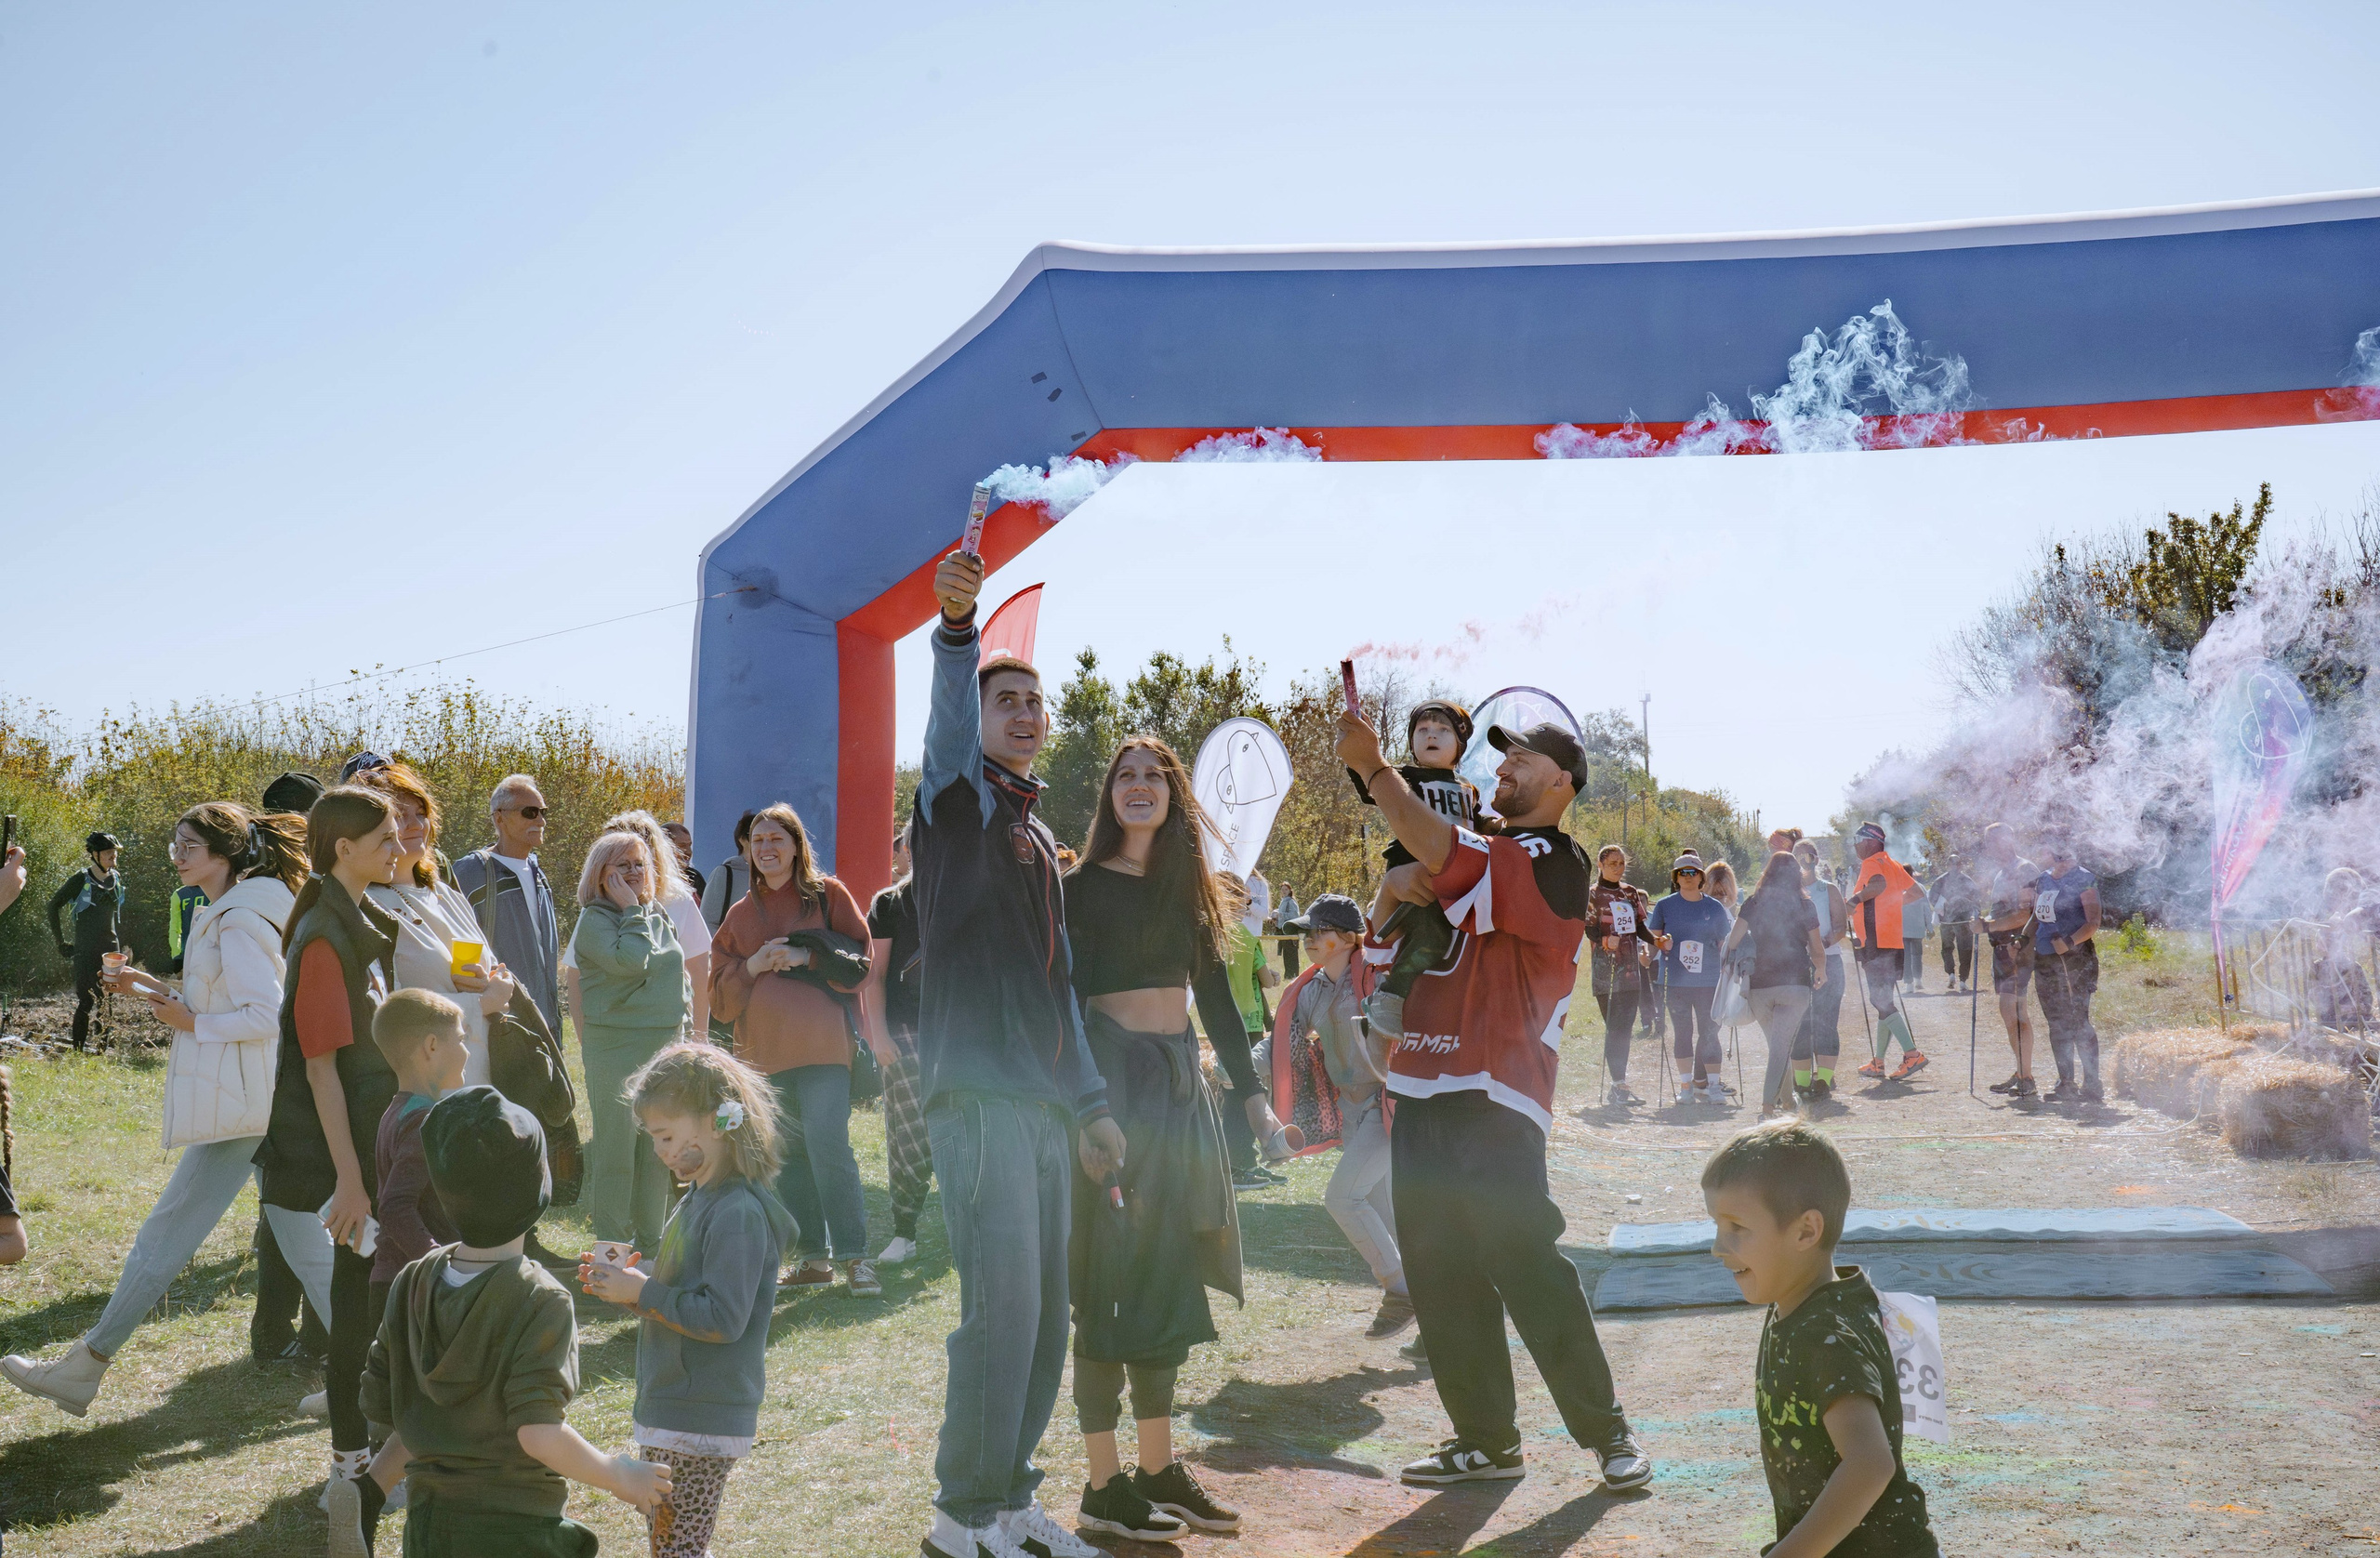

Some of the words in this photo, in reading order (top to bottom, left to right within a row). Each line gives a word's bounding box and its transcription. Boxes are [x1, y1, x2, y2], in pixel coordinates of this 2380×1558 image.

[181, 895, 212, 911] FO
[2037, 905, 2050, 914] 270
[1618, 917, 1633, 926] 254
[1683, 956, 1700, 965] 252
